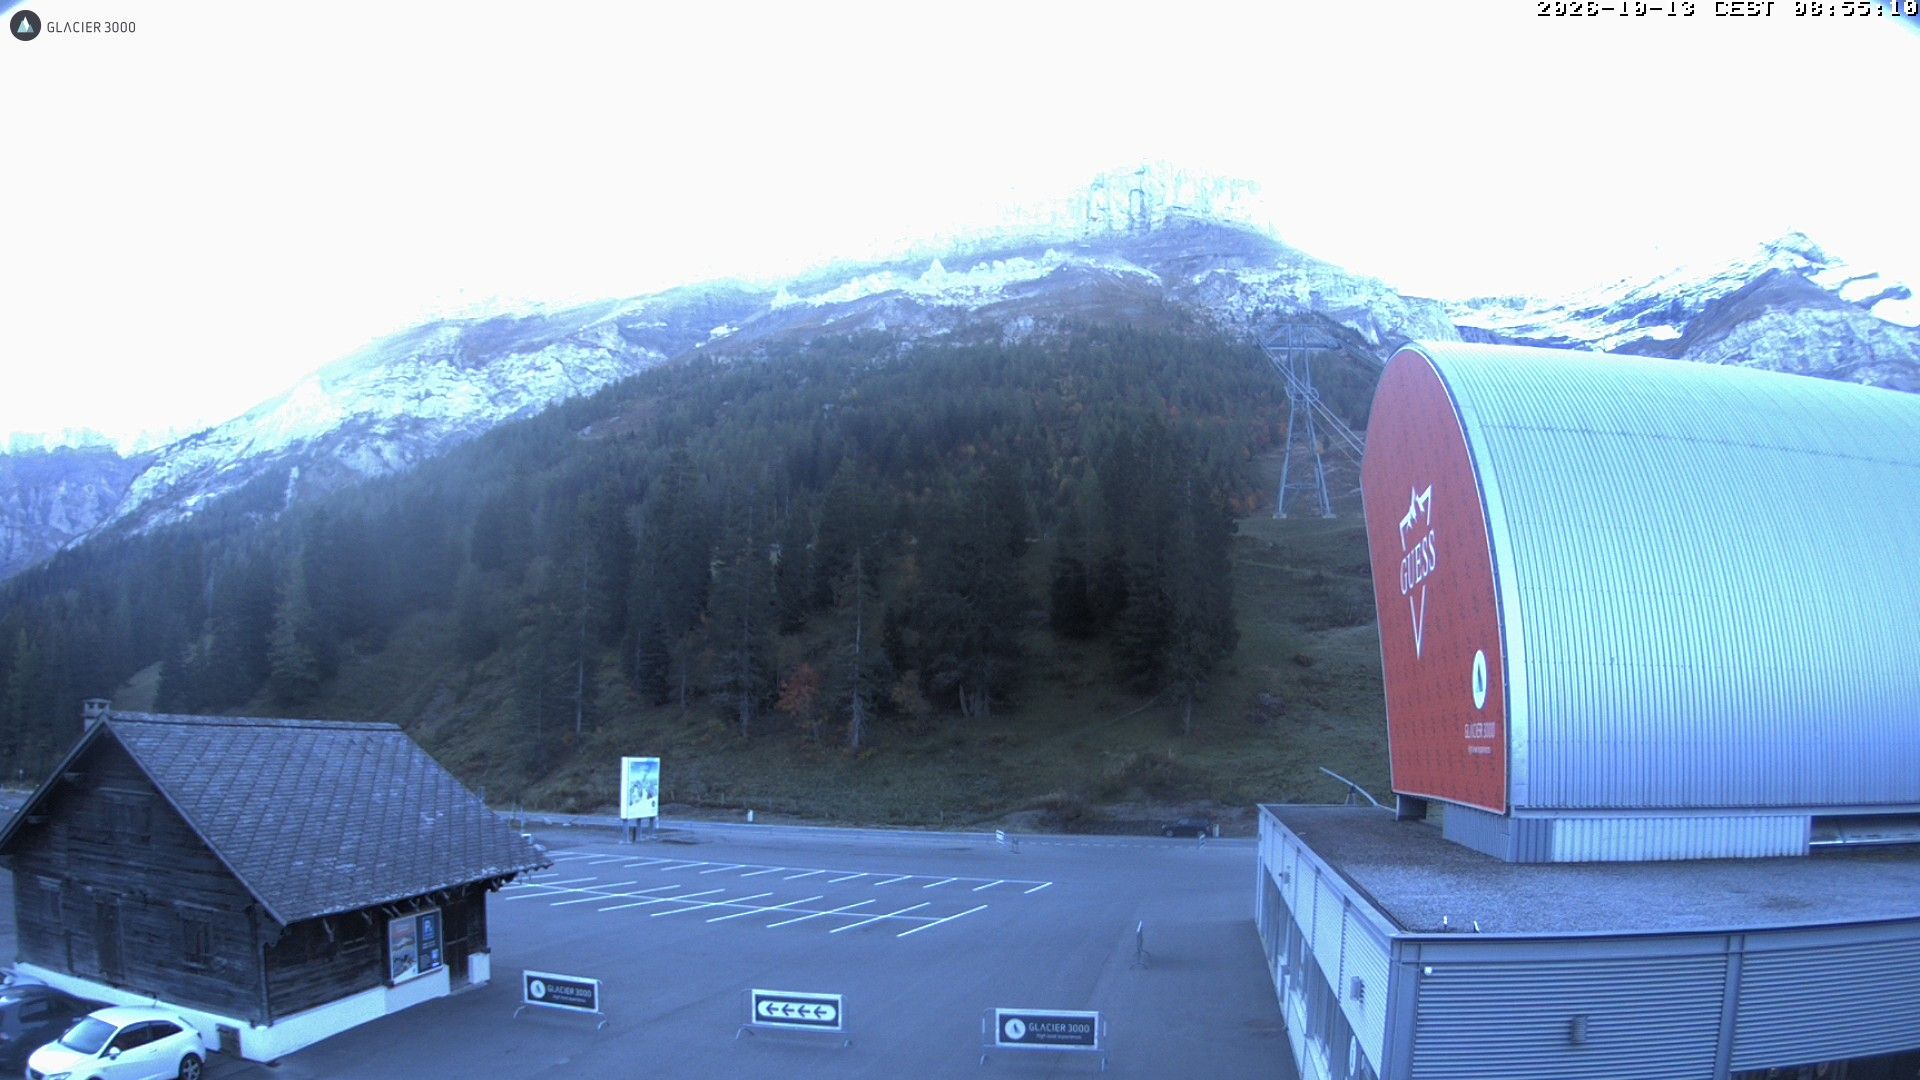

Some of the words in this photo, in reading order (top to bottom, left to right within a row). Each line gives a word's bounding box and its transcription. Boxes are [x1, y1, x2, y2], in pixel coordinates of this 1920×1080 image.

[1400, 529, 1436, 596] GUESS
[1028, 1022, 1066, 1032] GLACIER
[1067, 1023, 1090, 1033] 3000
